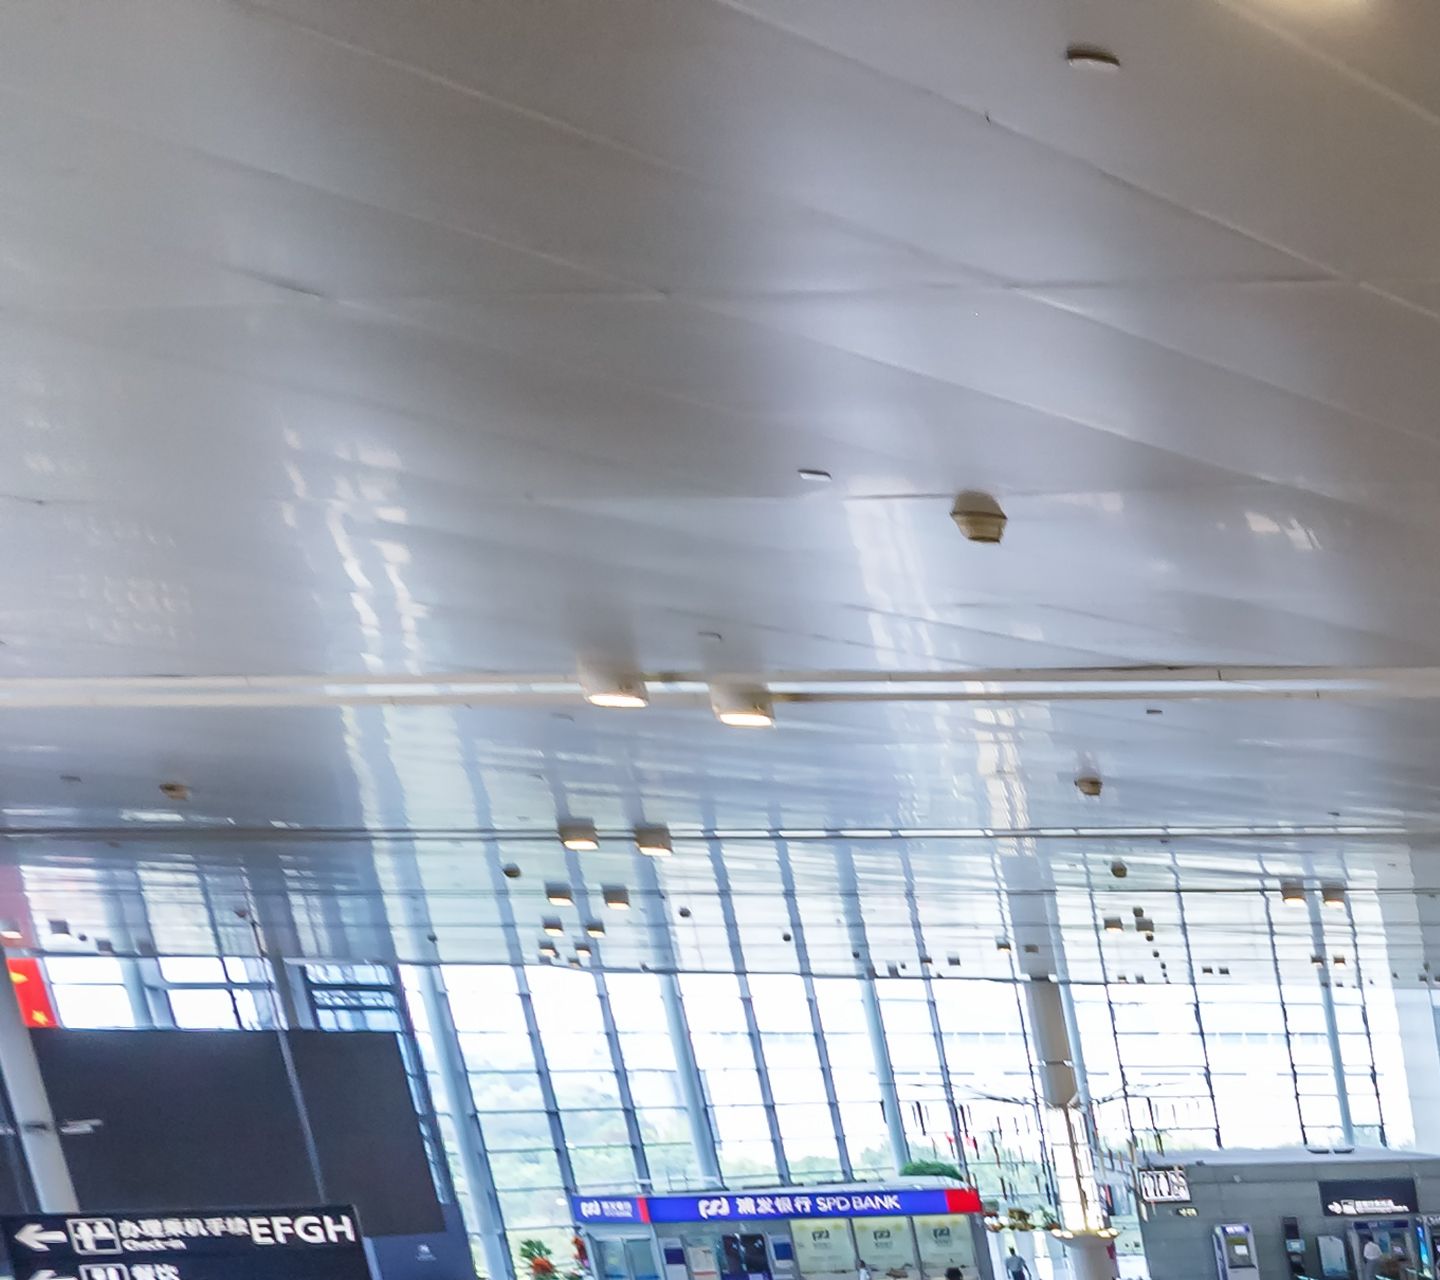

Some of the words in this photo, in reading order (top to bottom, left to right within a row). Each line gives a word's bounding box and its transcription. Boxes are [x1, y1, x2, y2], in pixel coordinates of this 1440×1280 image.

[816, 1196, 852, 1213] SPD
[853, 1194, 901, 1212] BANK
[250, 1214, 356, 1246] EFGH
